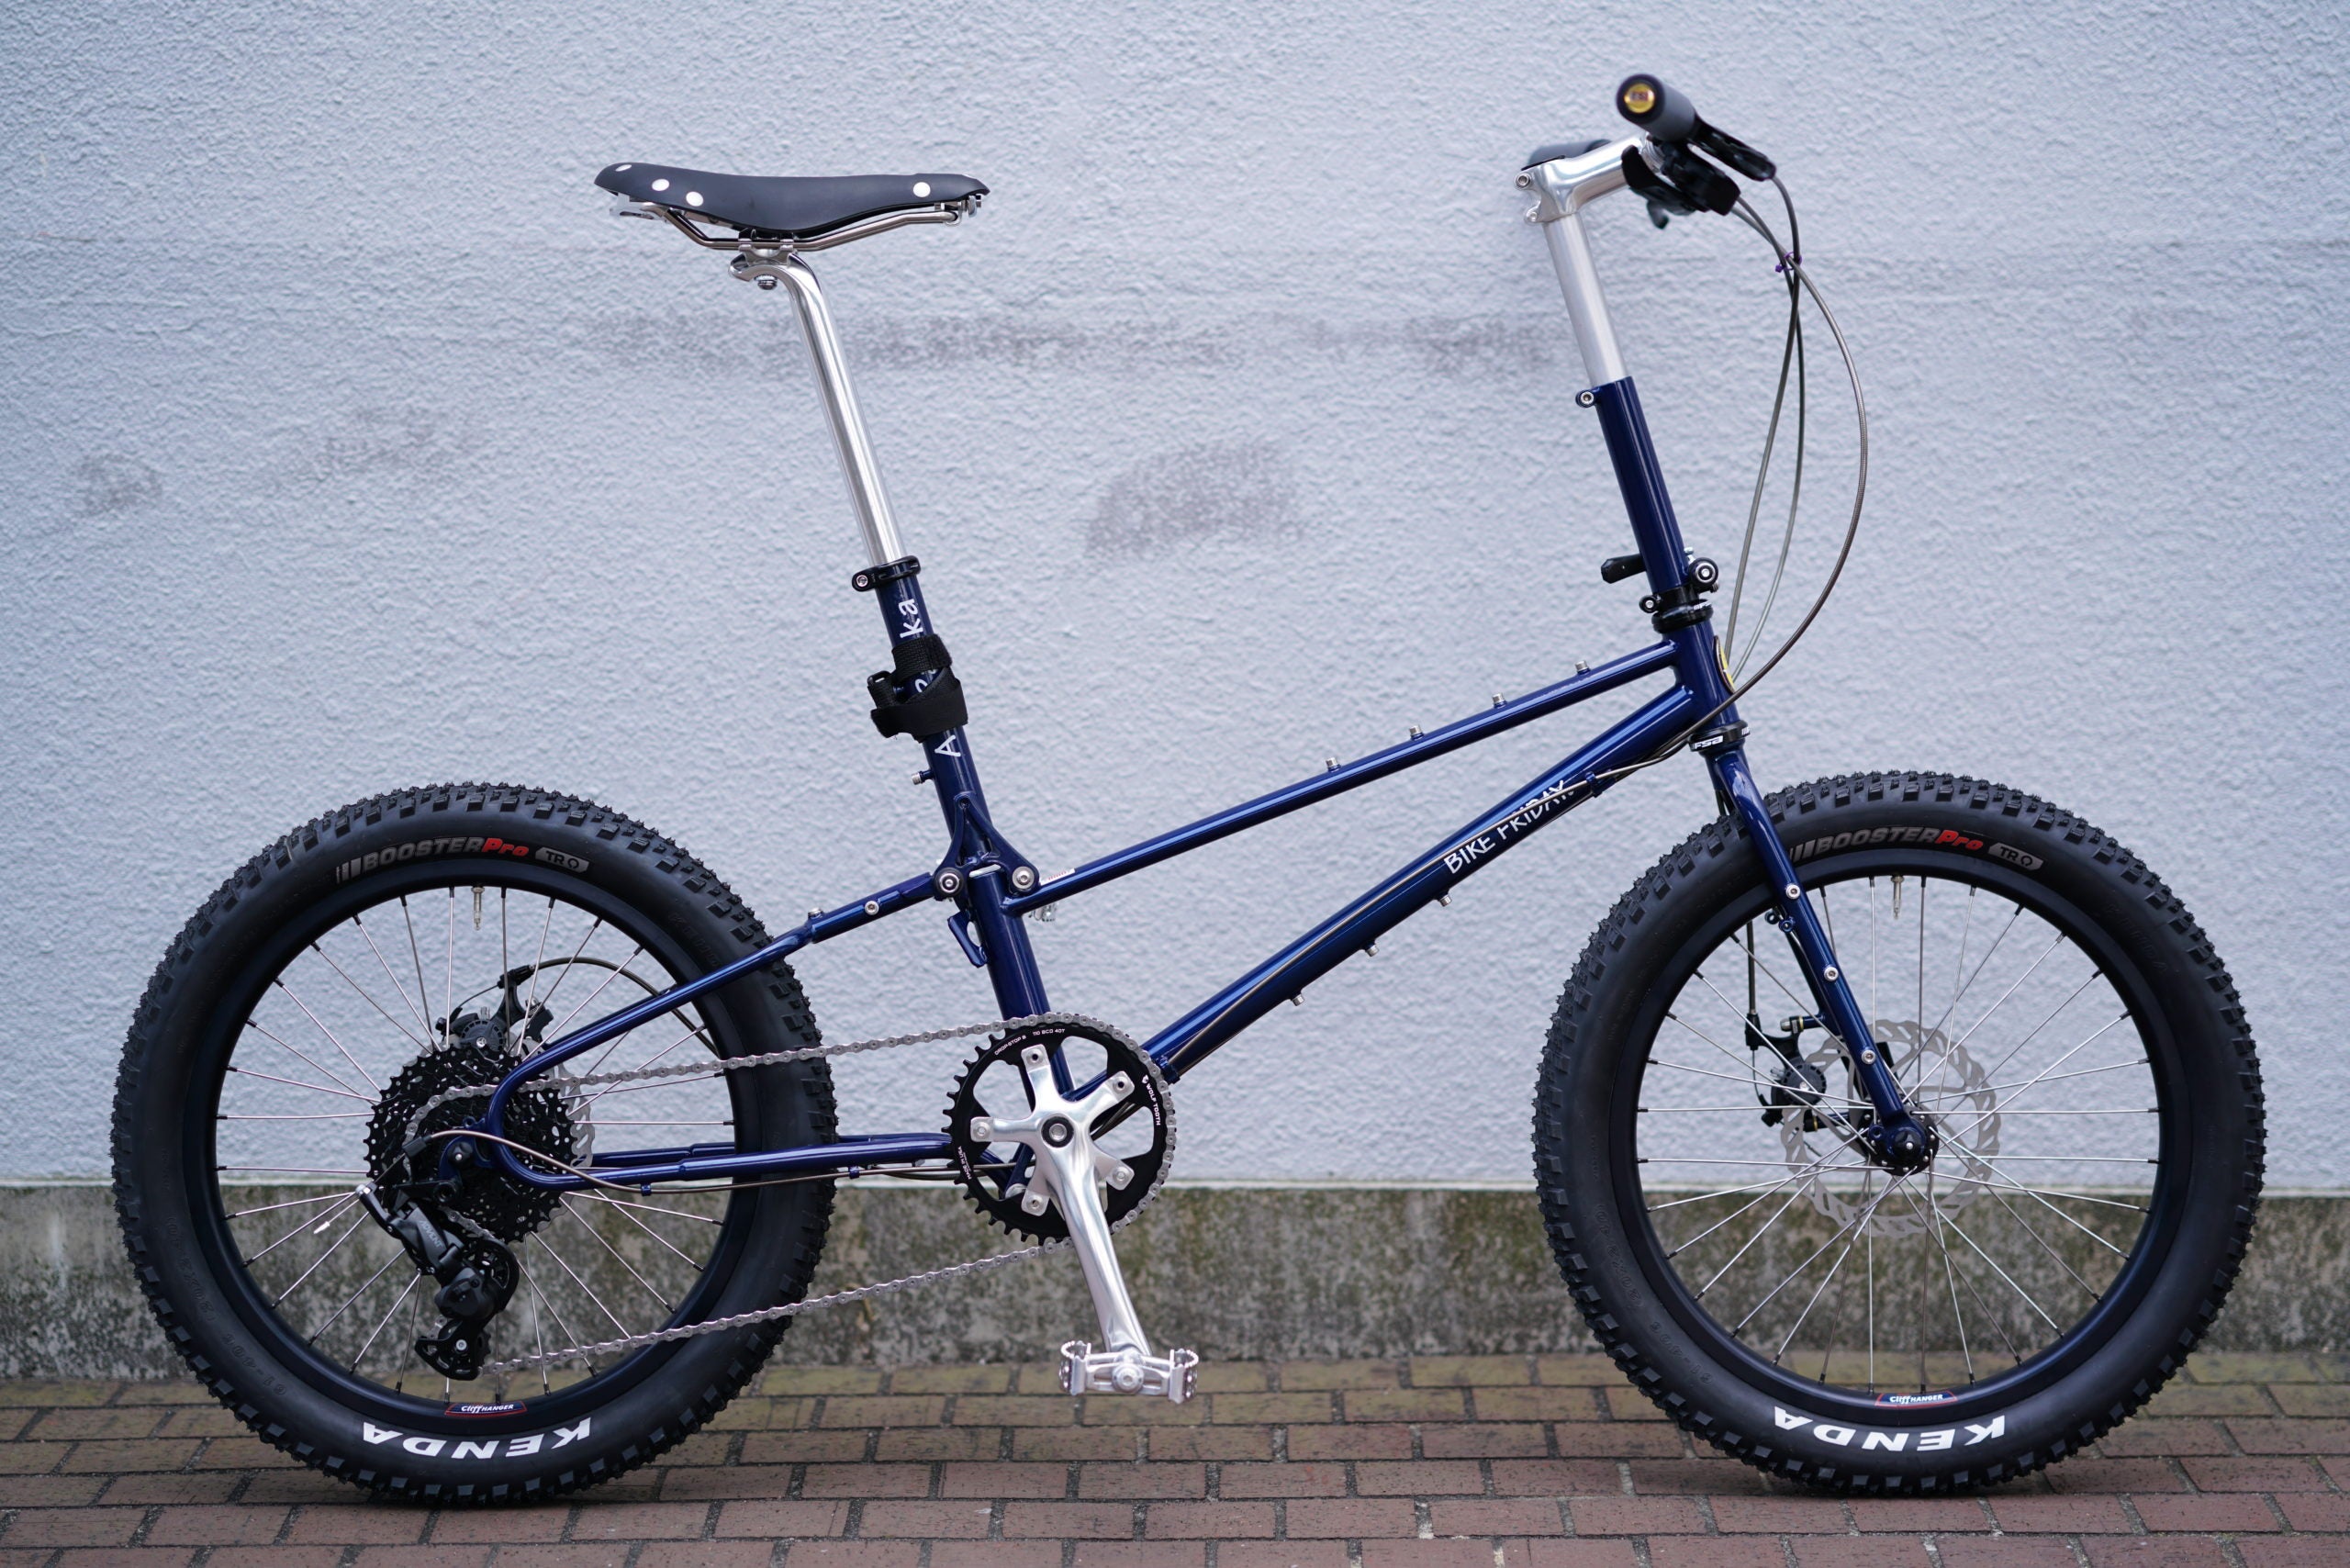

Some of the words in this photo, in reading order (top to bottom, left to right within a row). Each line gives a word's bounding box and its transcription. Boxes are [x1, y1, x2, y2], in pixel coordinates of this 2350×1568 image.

[1443, 836, 1496, 874] BIKE
[1146, 1083, 1157, 1102] WOLF
[1153, 1103, 1161, 1126] TOOTH
[419, 1219, 443, 1249] ADVENT
[363, 1417, 592, 1460] KENDA
[1774, 1406, 2006, 1452] KENDA
